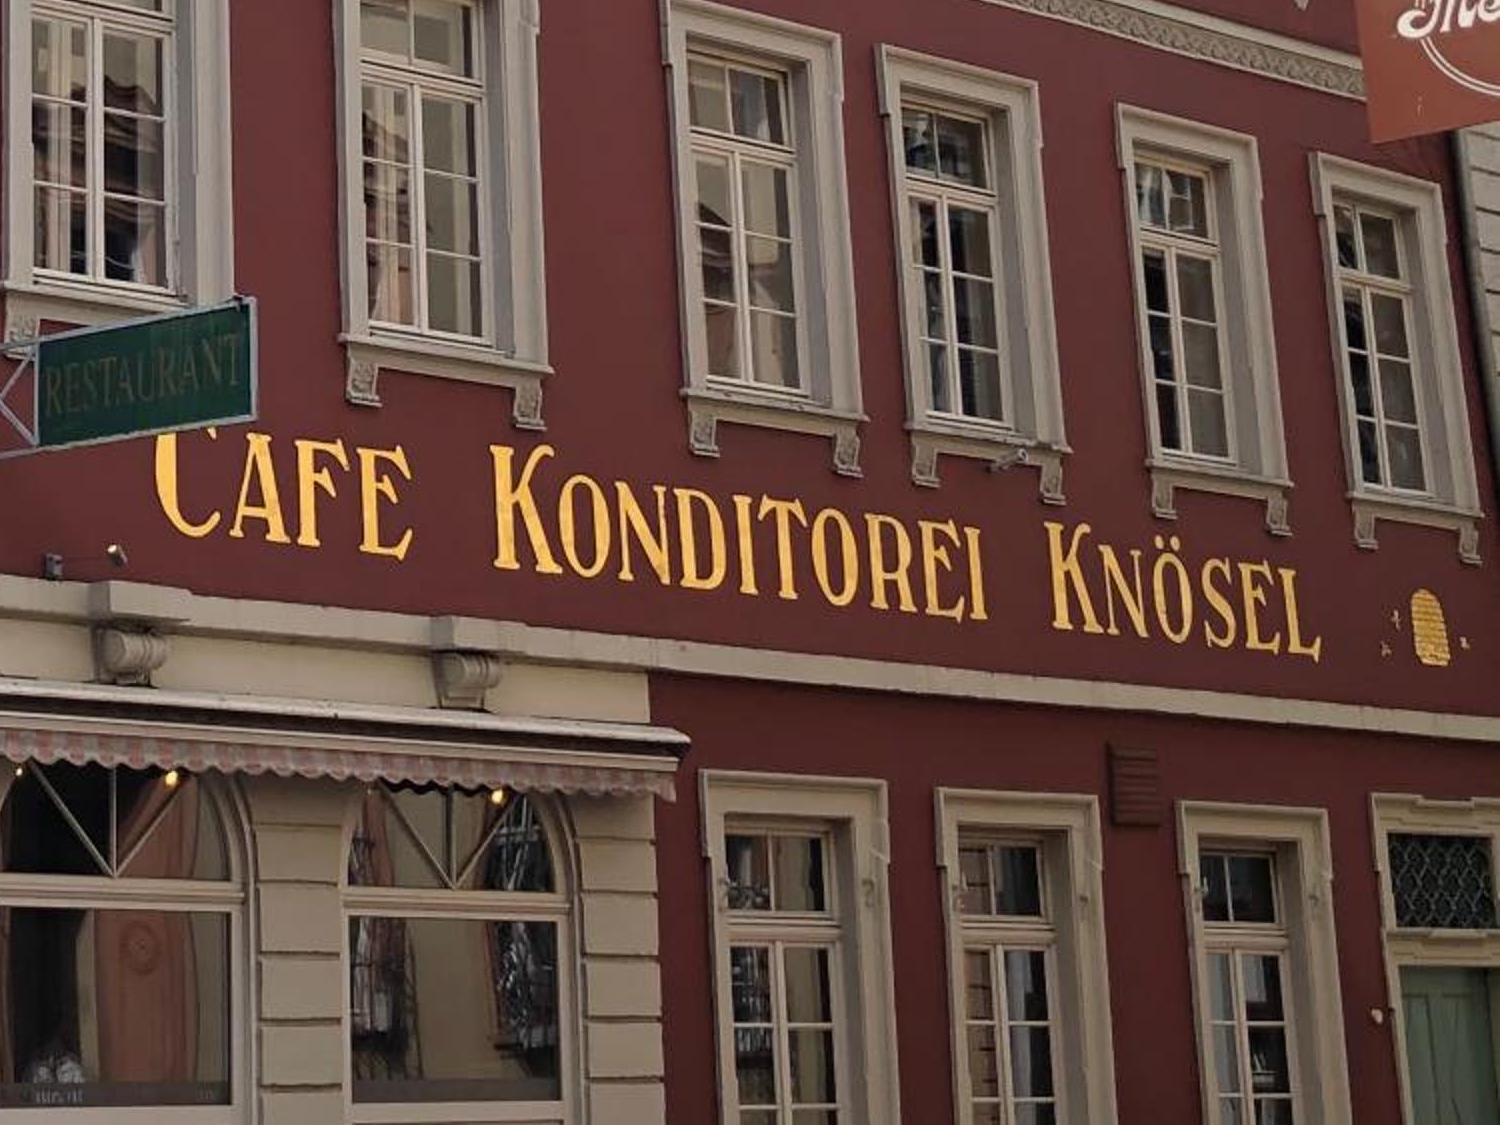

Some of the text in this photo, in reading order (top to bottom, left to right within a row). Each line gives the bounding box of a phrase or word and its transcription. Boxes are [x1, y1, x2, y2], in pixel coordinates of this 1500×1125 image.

[45, 332, 242, 417] RESTAURANT
[155, 427, 1322, 663] CAFE KONDITOREI KNÖSEL
